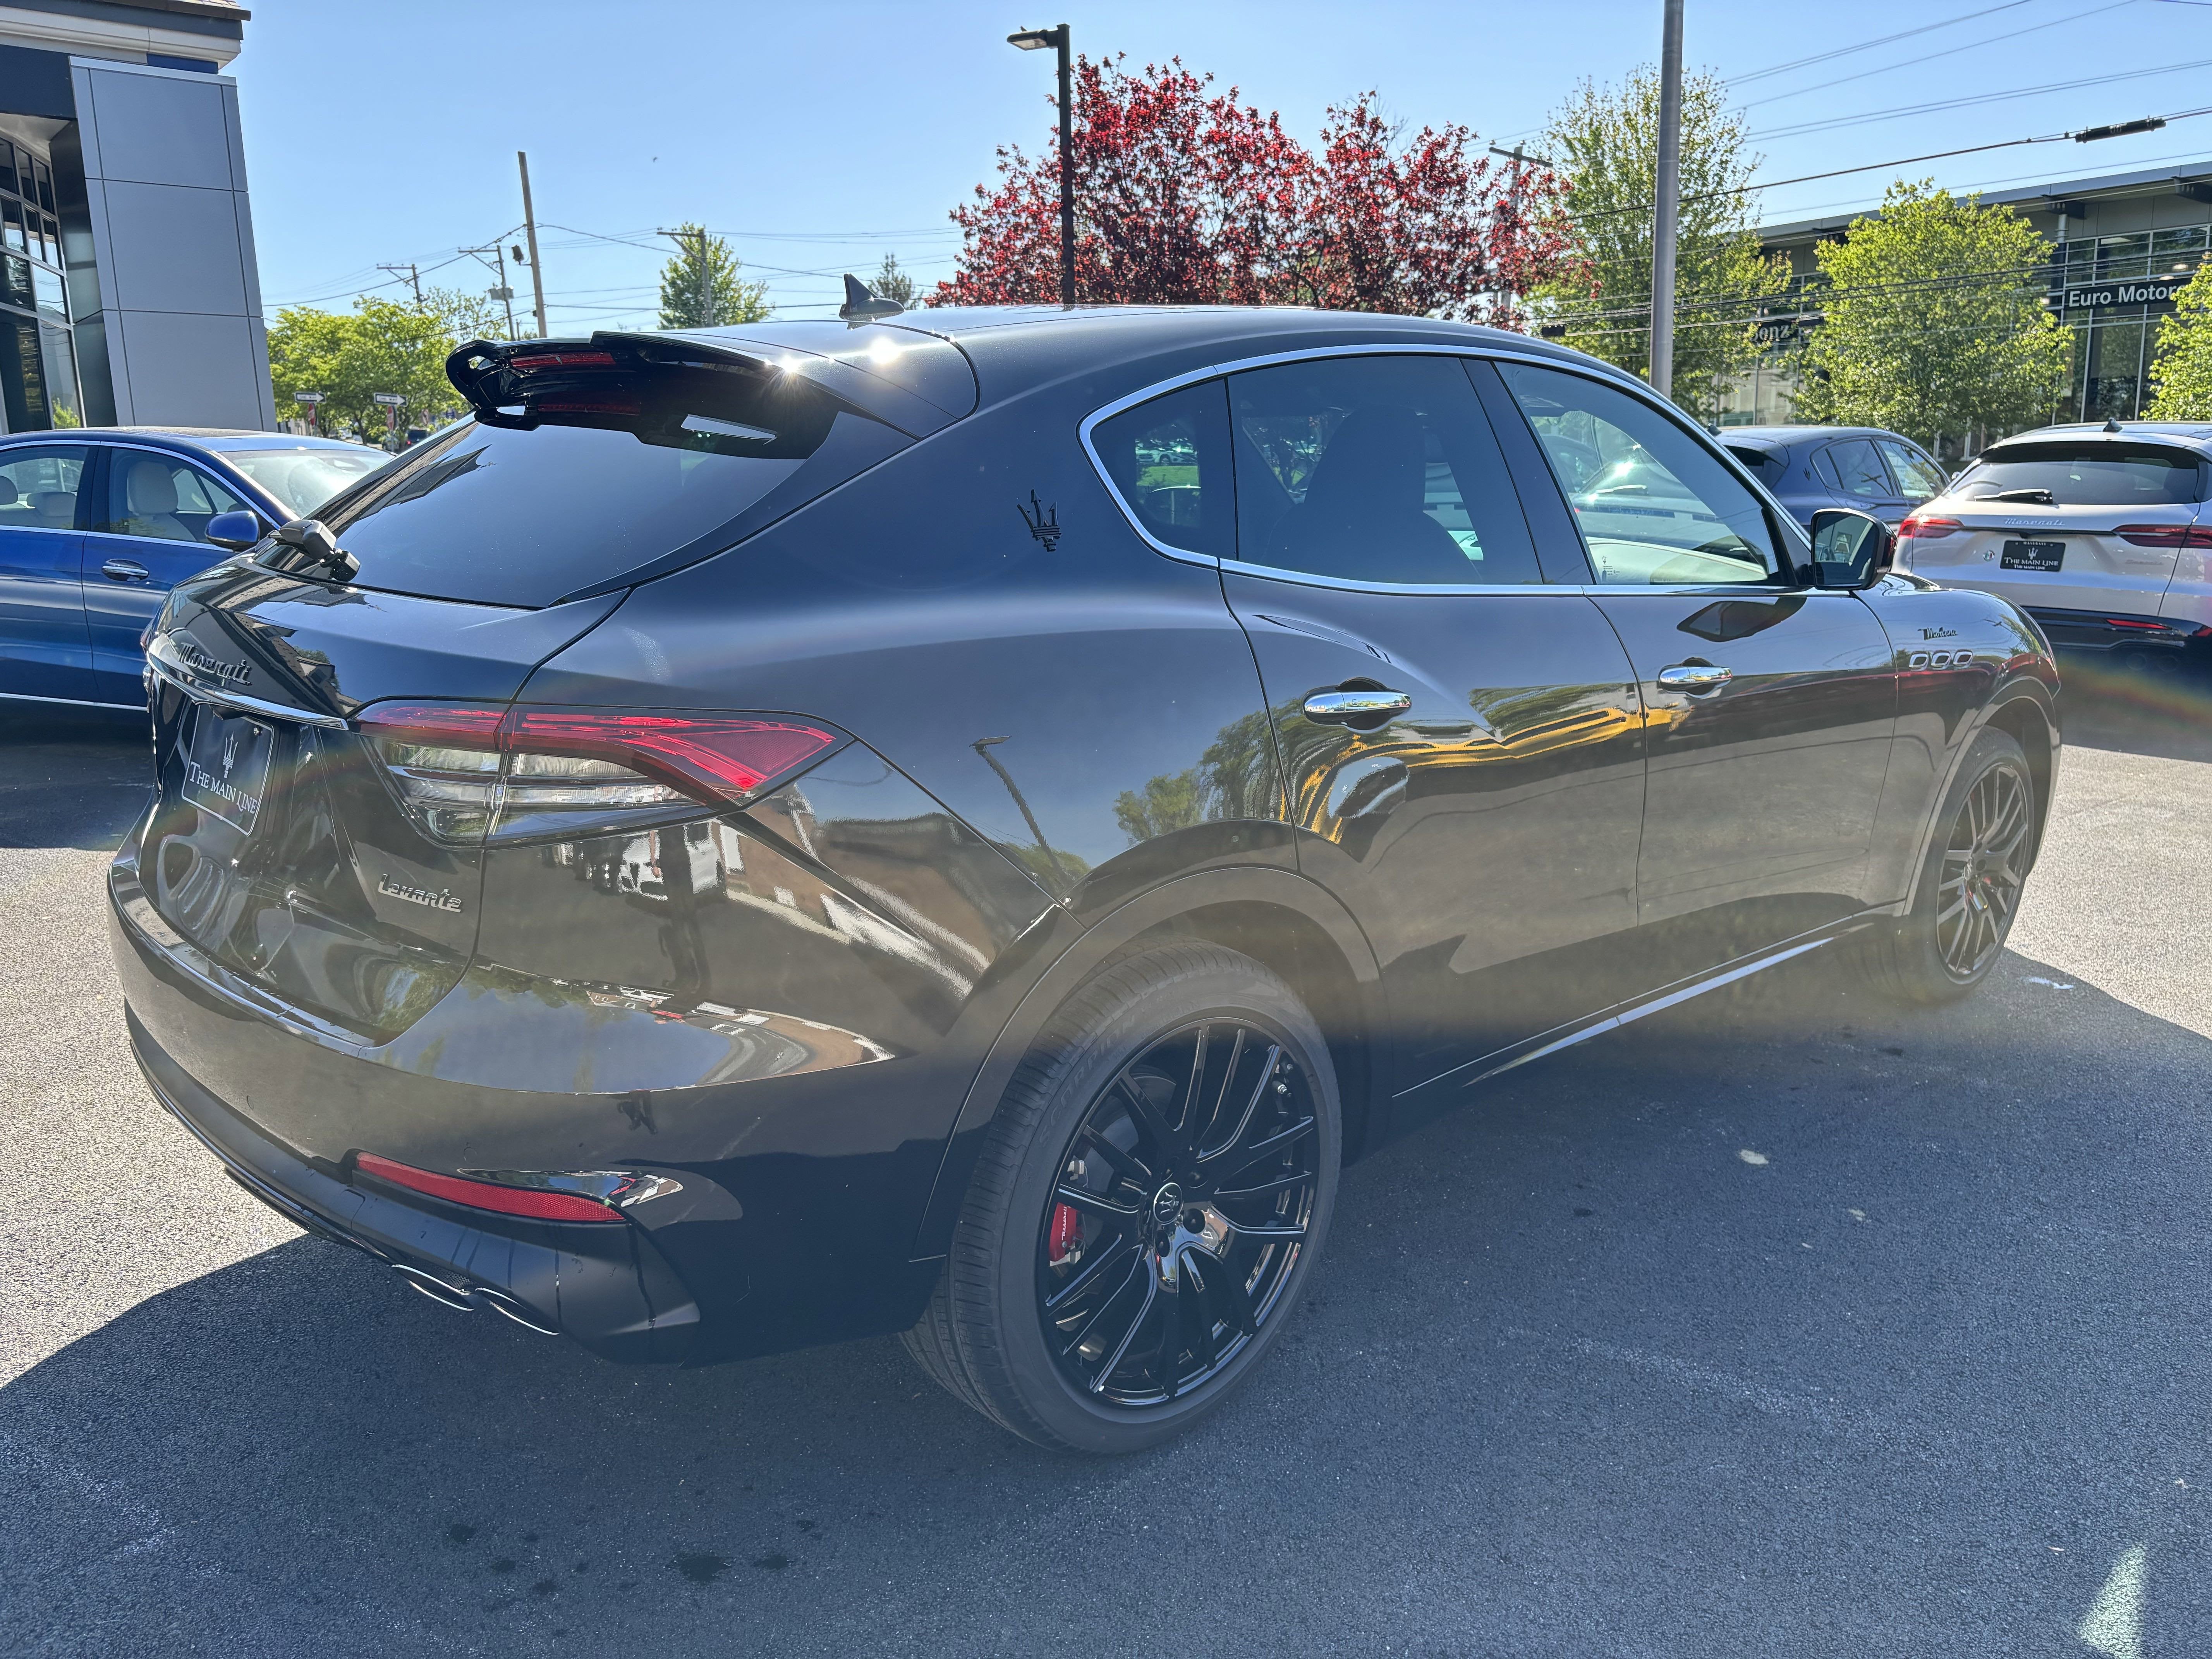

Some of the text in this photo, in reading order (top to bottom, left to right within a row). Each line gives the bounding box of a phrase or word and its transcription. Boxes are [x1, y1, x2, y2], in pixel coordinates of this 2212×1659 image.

[2069, 290, 2111, 307] Euro
[178, 642, 252, 685] Maserati
[189, 761, 257, 814] THE MAIN LINE
[378, 873, 462, 913] Levante
